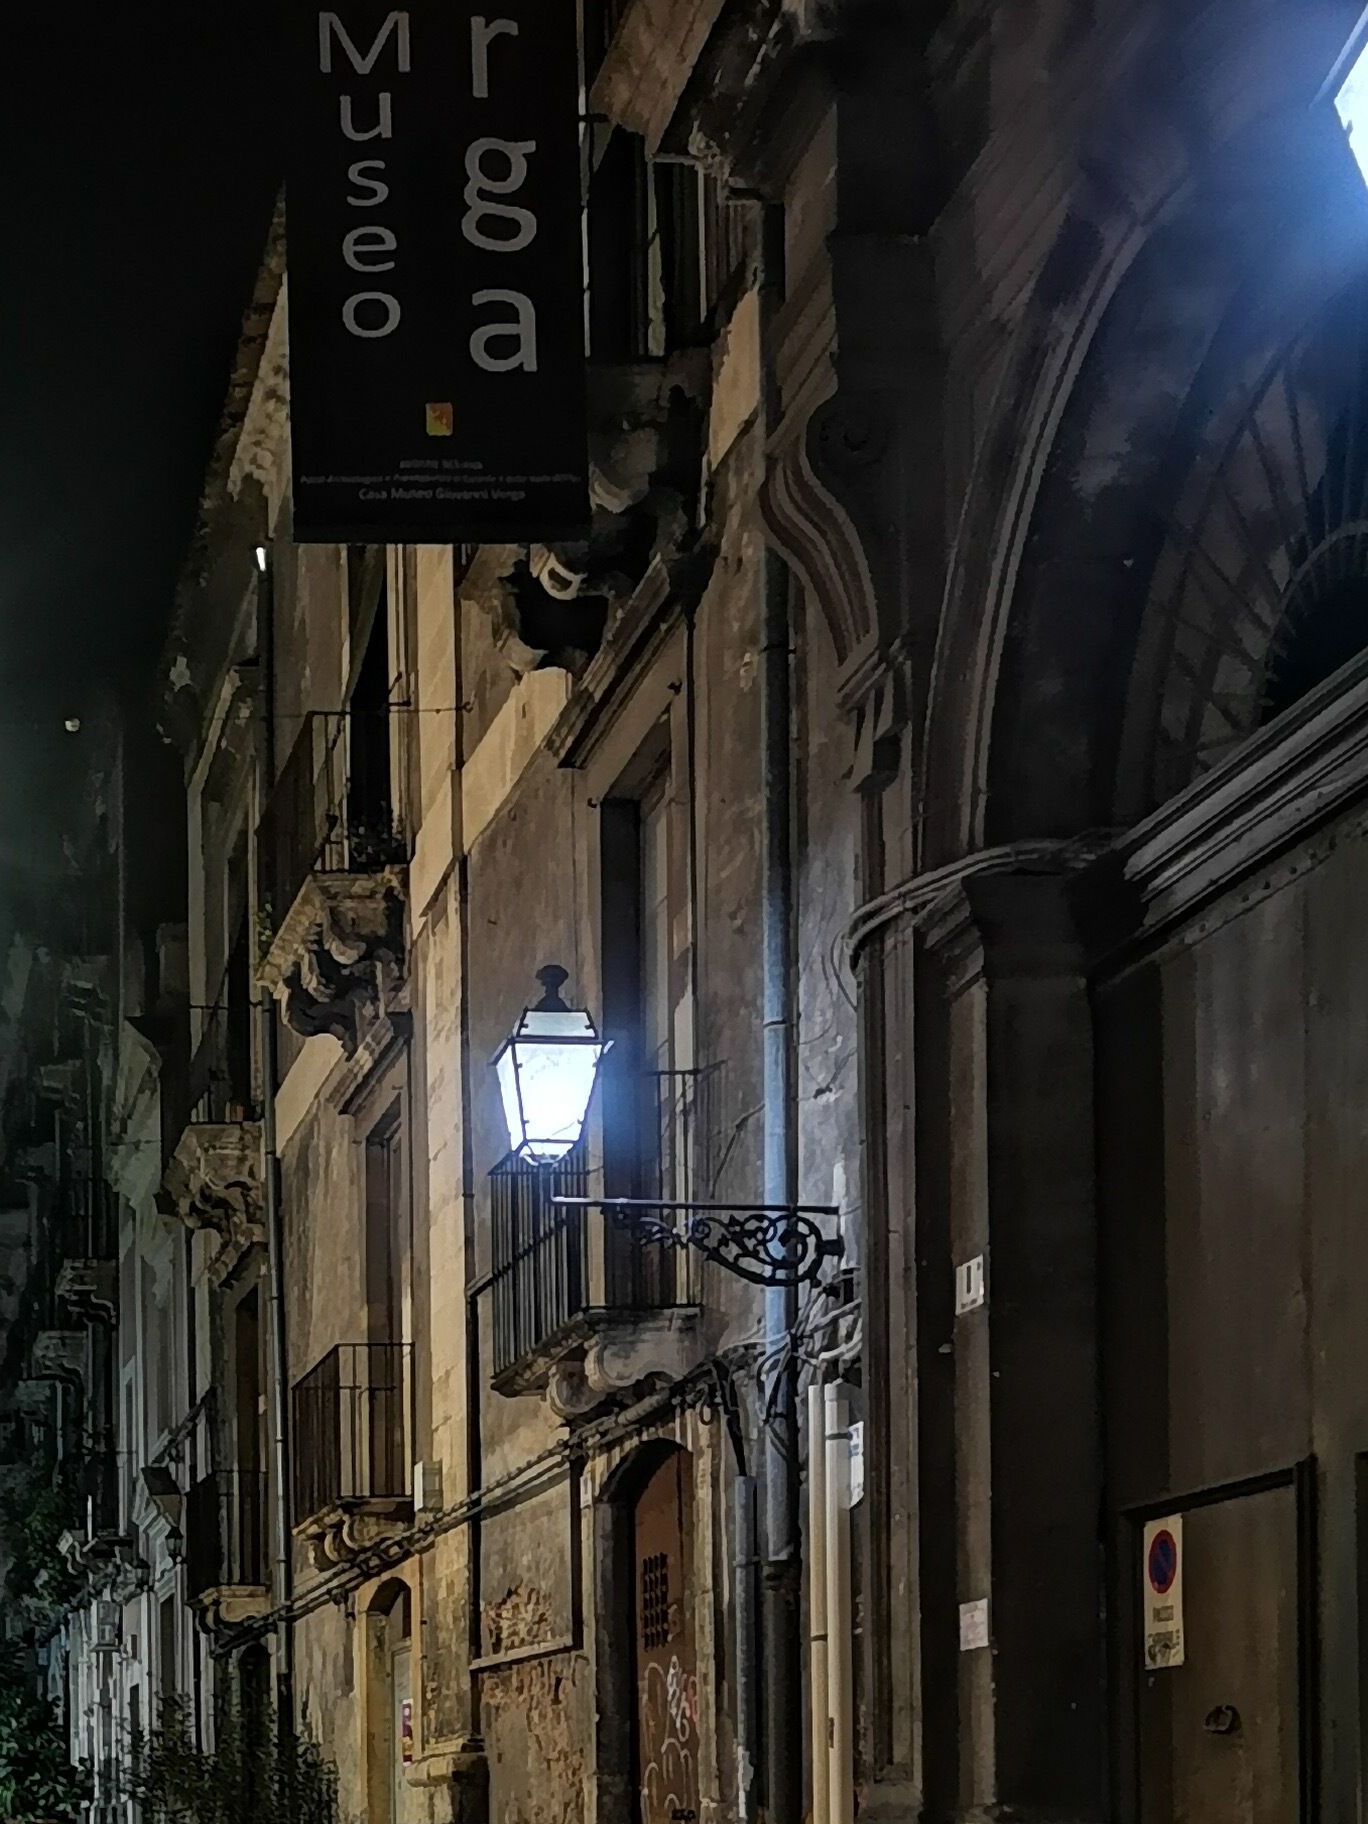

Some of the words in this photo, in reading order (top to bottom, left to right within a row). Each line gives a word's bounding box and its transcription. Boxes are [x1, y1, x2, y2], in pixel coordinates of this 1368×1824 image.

[319, 11, 411, 338] Museo
[461, 15, 538, 373] rga
[390, 487, 433, 500] Museo
